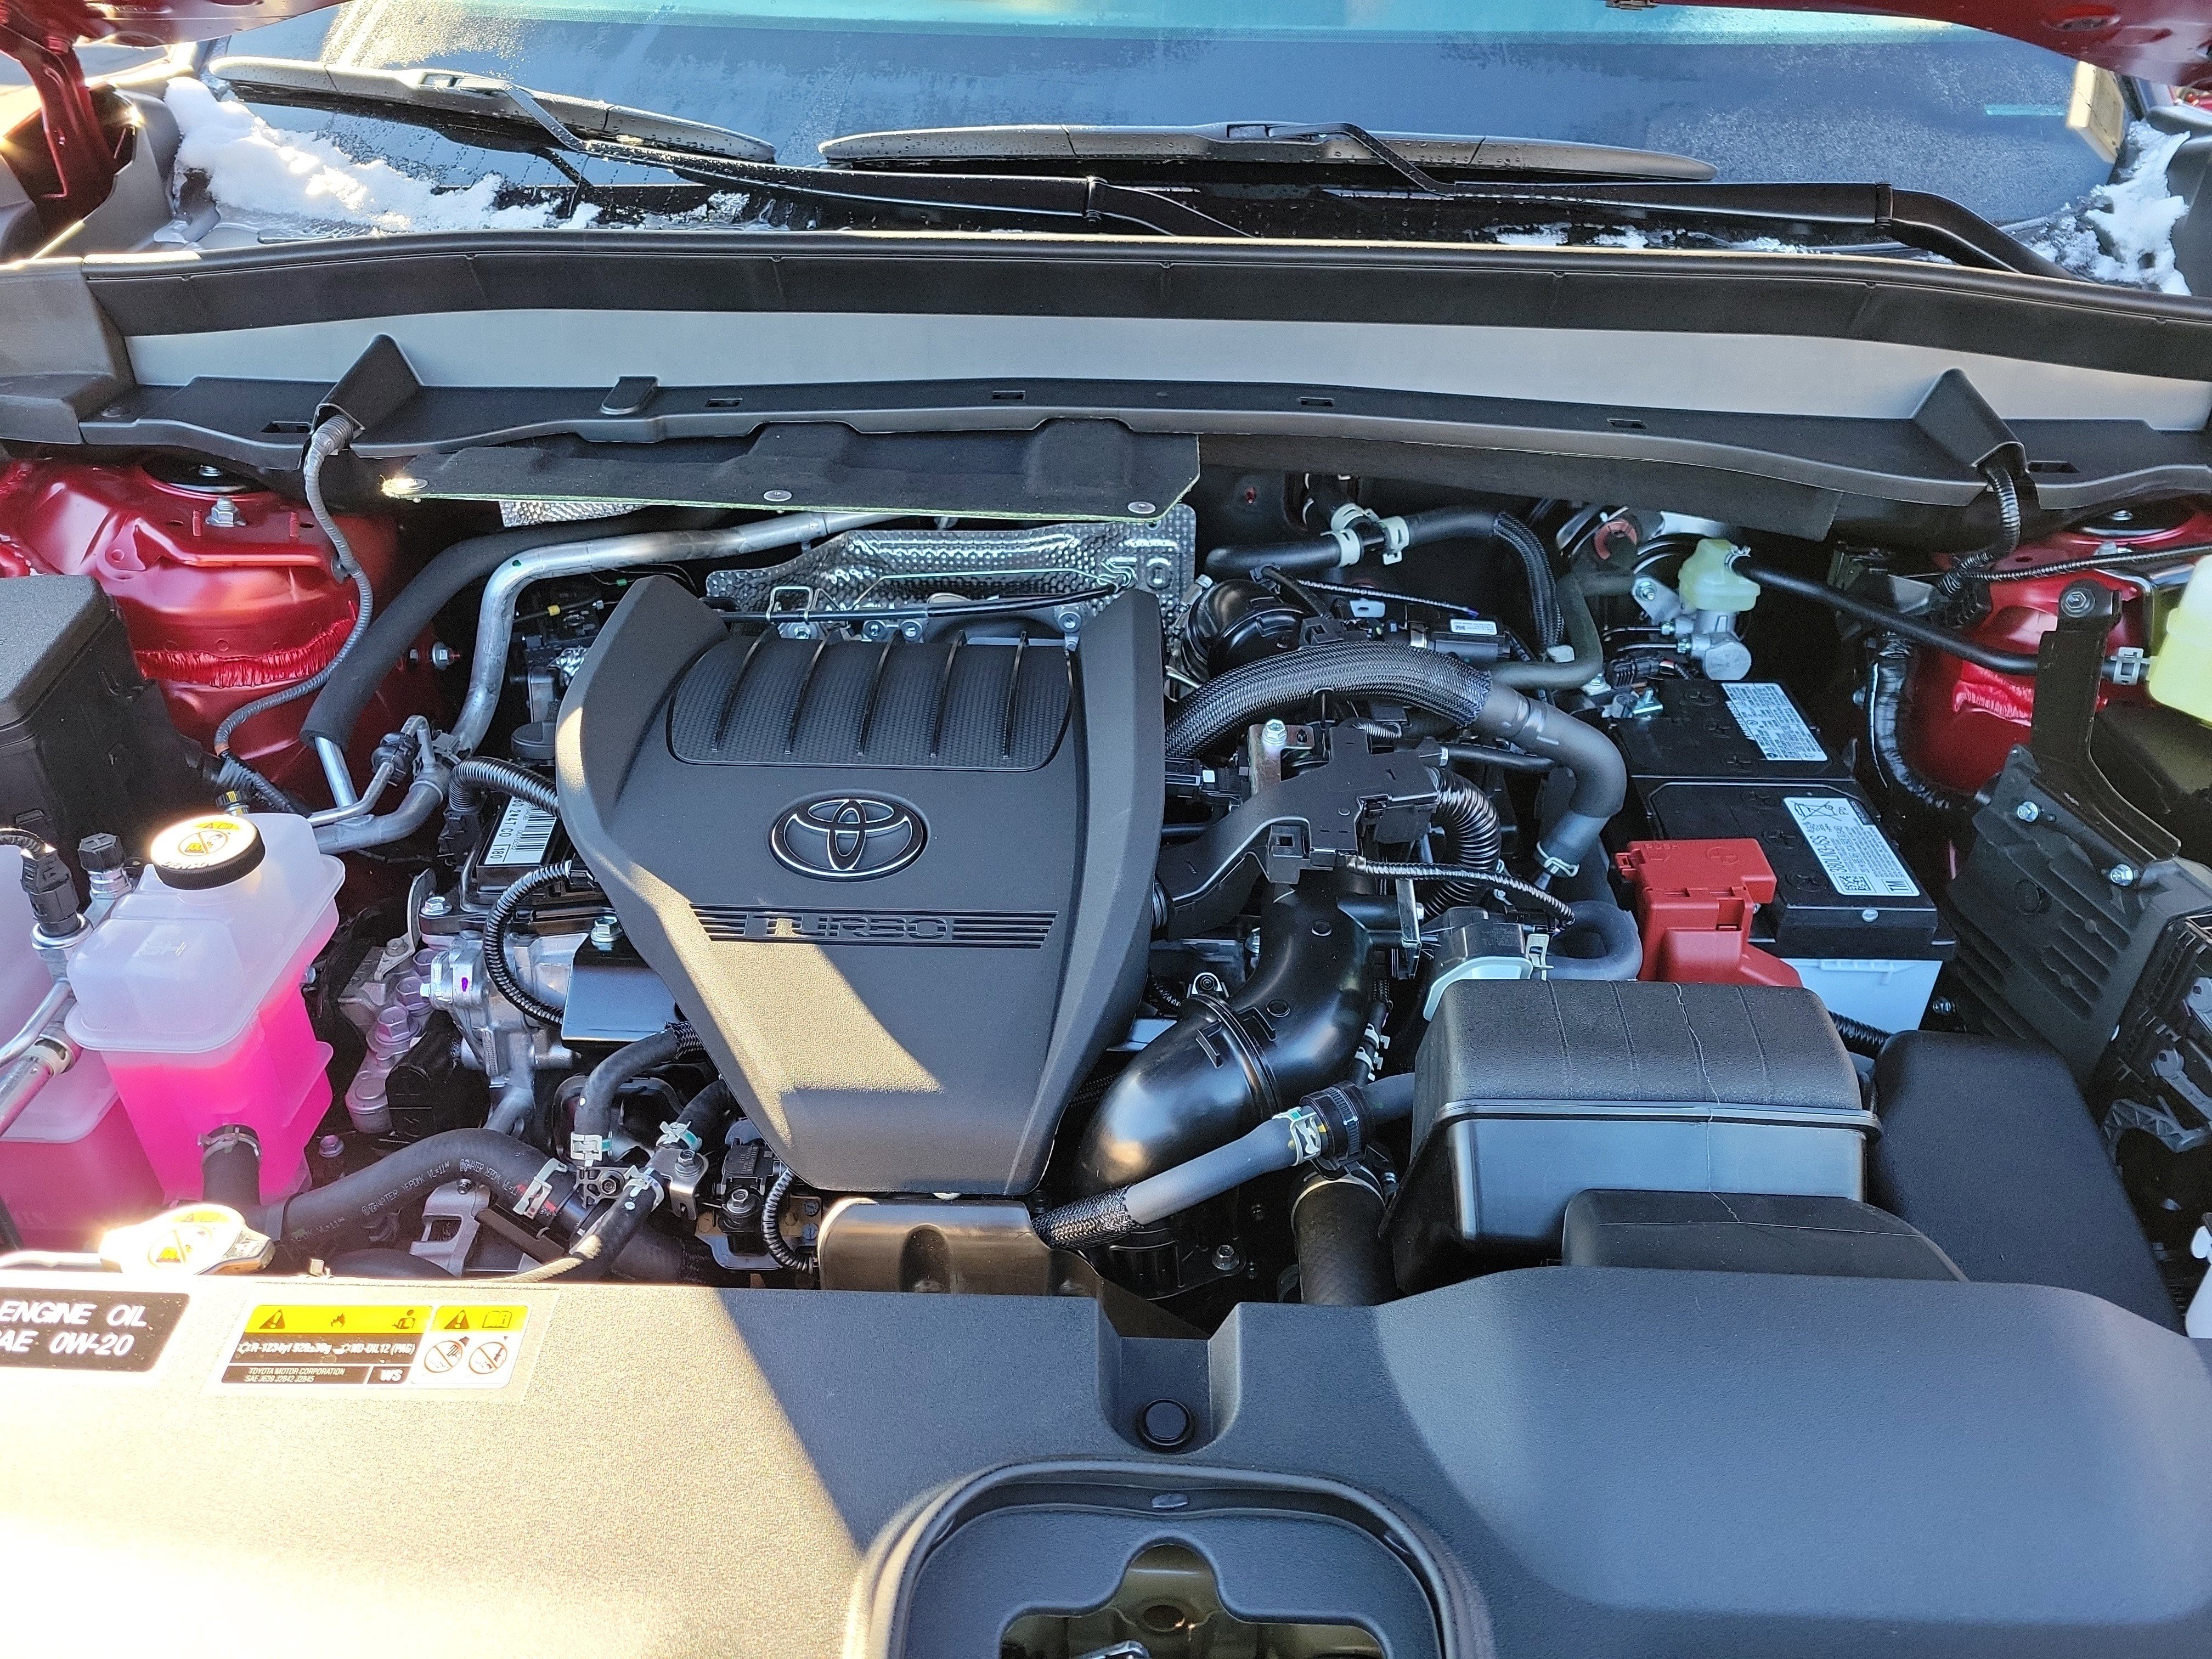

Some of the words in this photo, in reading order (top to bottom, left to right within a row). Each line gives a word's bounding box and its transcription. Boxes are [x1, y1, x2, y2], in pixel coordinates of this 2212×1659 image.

[490, 848, 505, 859] 180
[1810, 836, 1847, 873] 380LN3-ISS
[1885, 880, 1910, 891] TM
[752, 913, 950, 939] TURBO
[0, 1301, 98, 1324] ENGINE
[106, 1304, 148, 1327] OIL
[0, 1330, 39, 1352] AE
[49, 1331, 135, 1356] 0W-20
[390, 1343, 416, 1356] (PAG)
[380, 1368, 404, 1382] WS
